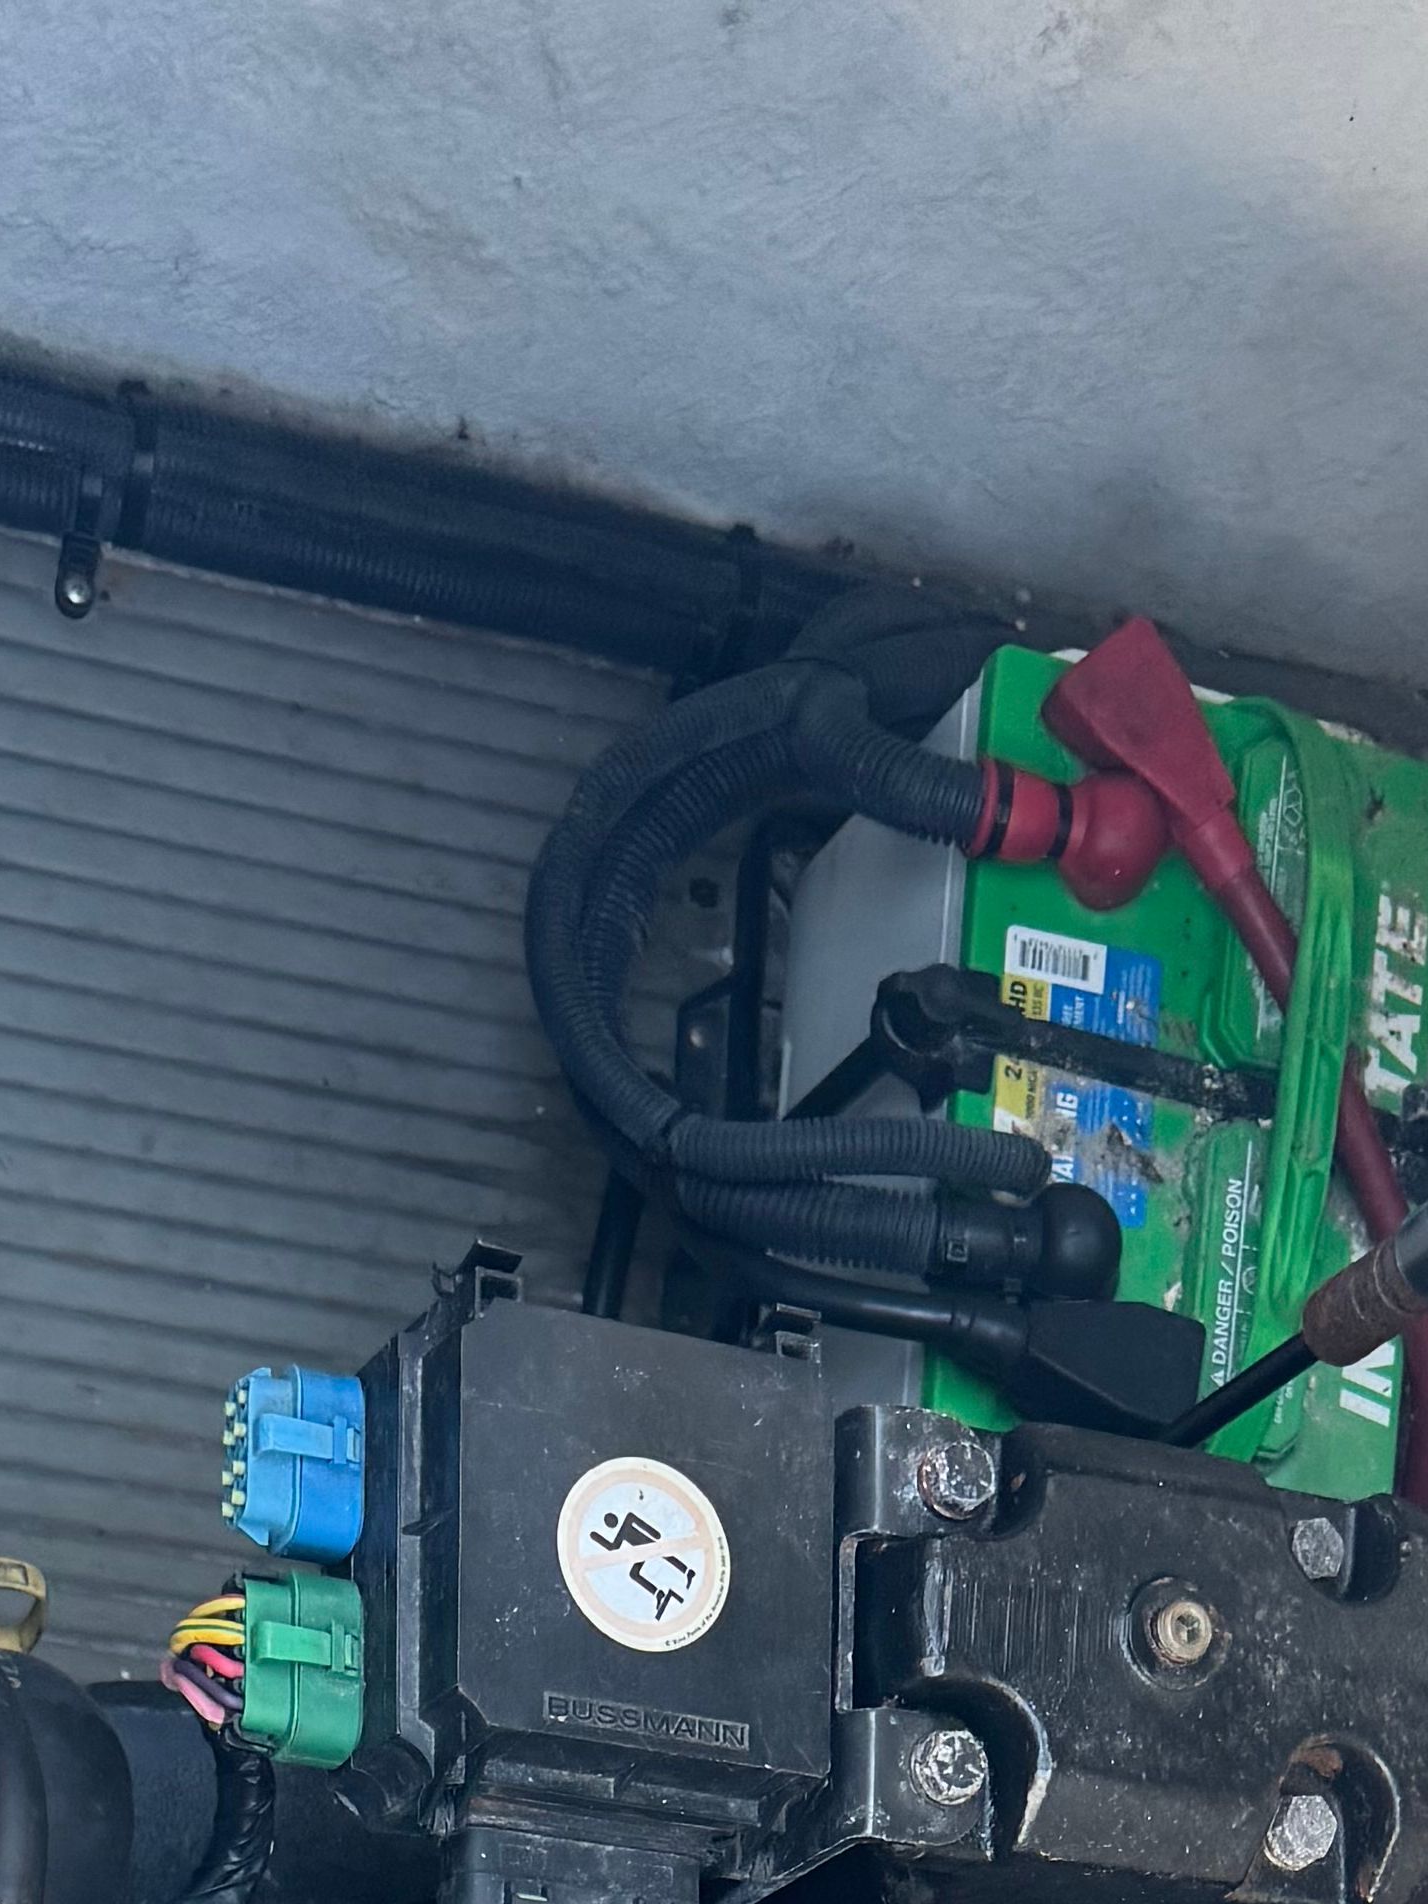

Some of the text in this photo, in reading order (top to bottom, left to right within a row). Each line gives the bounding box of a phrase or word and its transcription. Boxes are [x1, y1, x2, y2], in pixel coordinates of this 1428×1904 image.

[1222, 1178, 1242, 1257] POISON
[1211, 1279, 1235, 1366] DANGER
[545, 1694, 749, 1748] BUSSMANN
